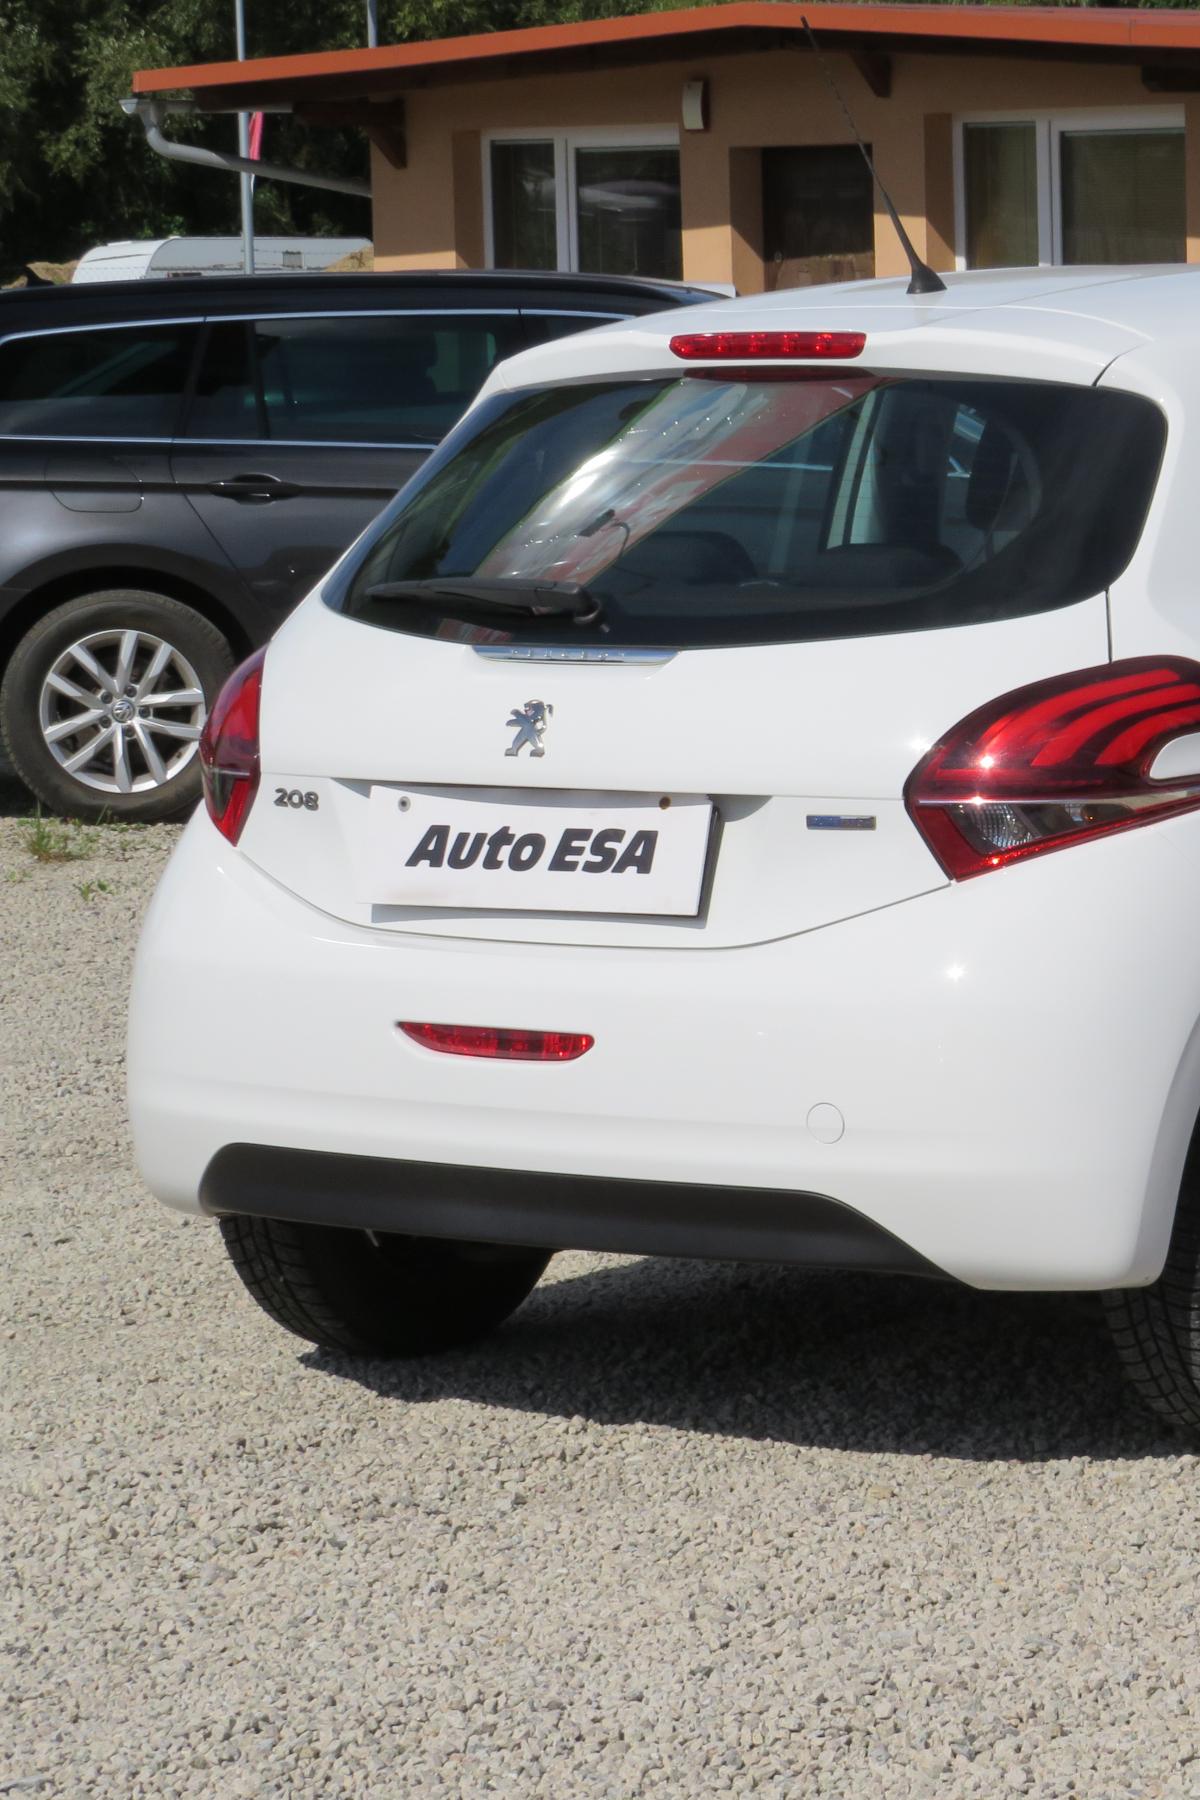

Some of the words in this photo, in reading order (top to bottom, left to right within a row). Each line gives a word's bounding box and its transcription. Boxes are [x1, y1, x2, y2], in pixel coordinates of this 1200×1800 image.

[273, 787, 319, 811] 208
[404, 824, 547, 872] Auto
[548, 828, 659, 874] ESA
